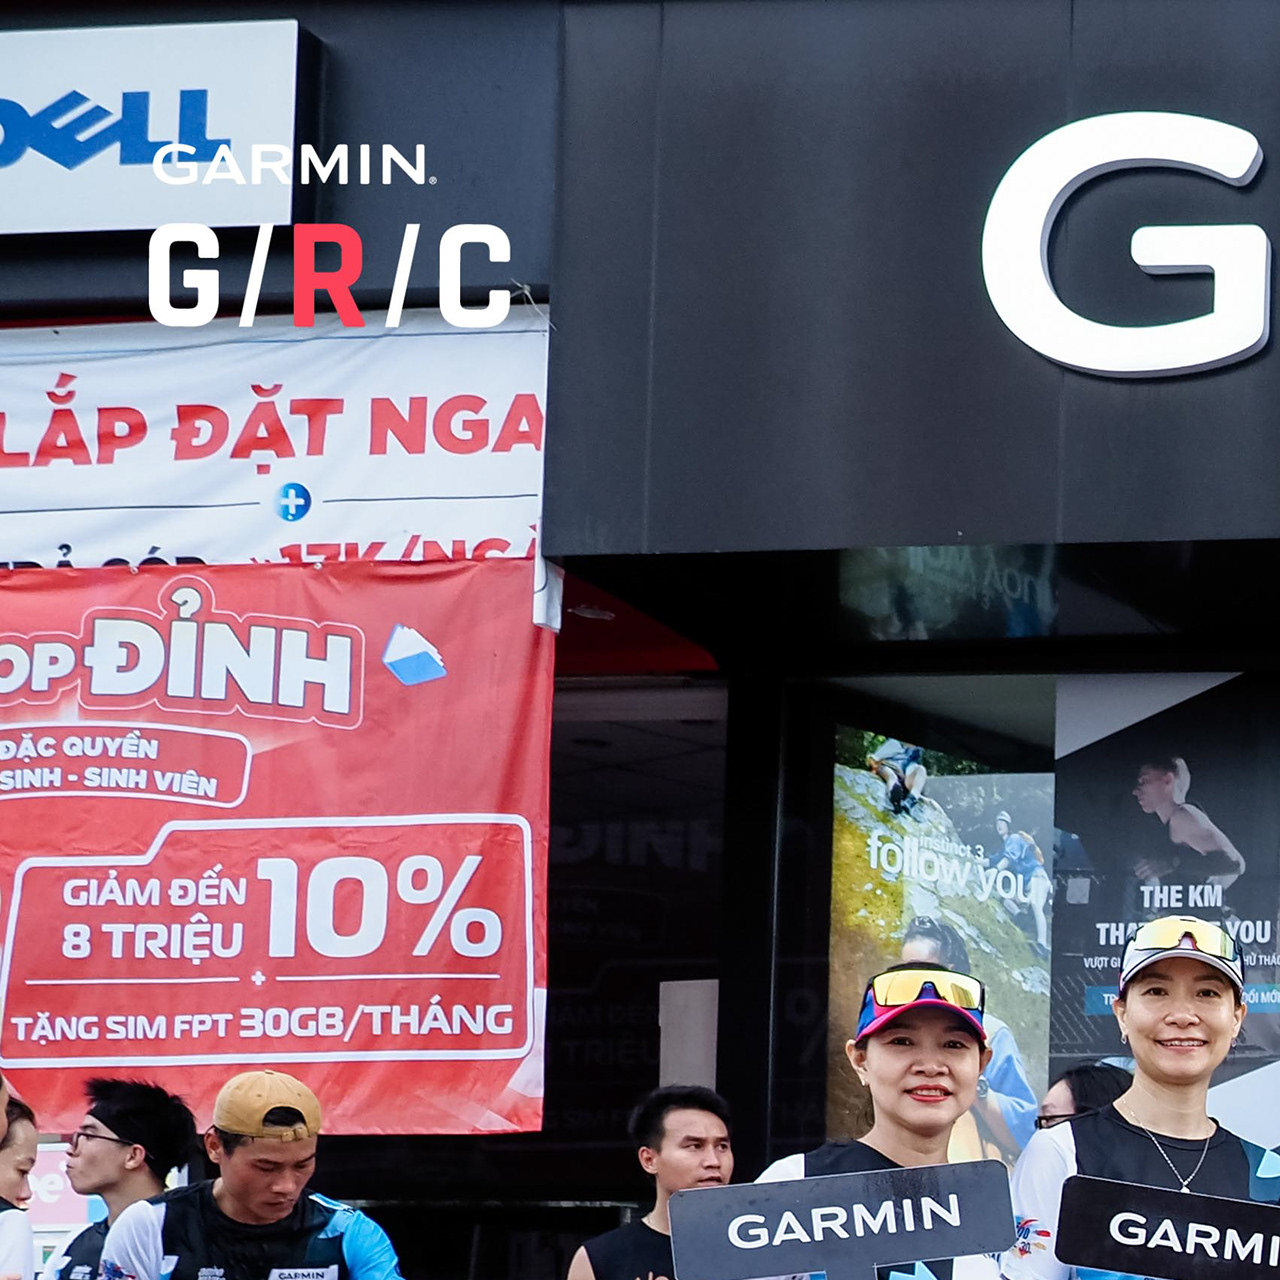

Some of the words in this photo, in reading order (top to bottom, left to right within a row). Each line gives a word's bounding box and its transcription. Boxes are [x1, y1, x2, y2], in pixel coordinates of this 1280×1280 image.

[0, 373, 148, 468] LẮP
[171, 384, 344, 474] ĐẶT
[84, 587, 352, 714] ĐỈNH
[63, 730, 158, 761] QUYỀN
[0, 769, 61, 790] SINH
[84, 769, 148, 790] SINH
[154, 768, 218, 798] VIÊN
[868, 834, 969, 890] follow
[918, 834, 972, 858] instinct
[974, 844, 985, 861] 3
[63, 870, 160, 907] GIẢM
[168, 863, 247, 906] ĐẾN
[256, 855, 502, 958] 10%
[1140, 887, 1183, 908] THE
[1188, 885, 1223, 907] KM
[61, 924, 91, 959] 8
[100, 913, 244, 965] TRIỆU
[1227, 921, 1271, 944] YOU
[11, 1012, 98, 1046] TẶNG
[106, 1015, 167, 1039] SIM
[173, 1013, 233, 1037] FPT
[239, 994, 513, 1042] 30GB/THÁNG
[727, 1194, 962, 1249] GARMIN
[278, 1271, 325, 1280] GARMIN
